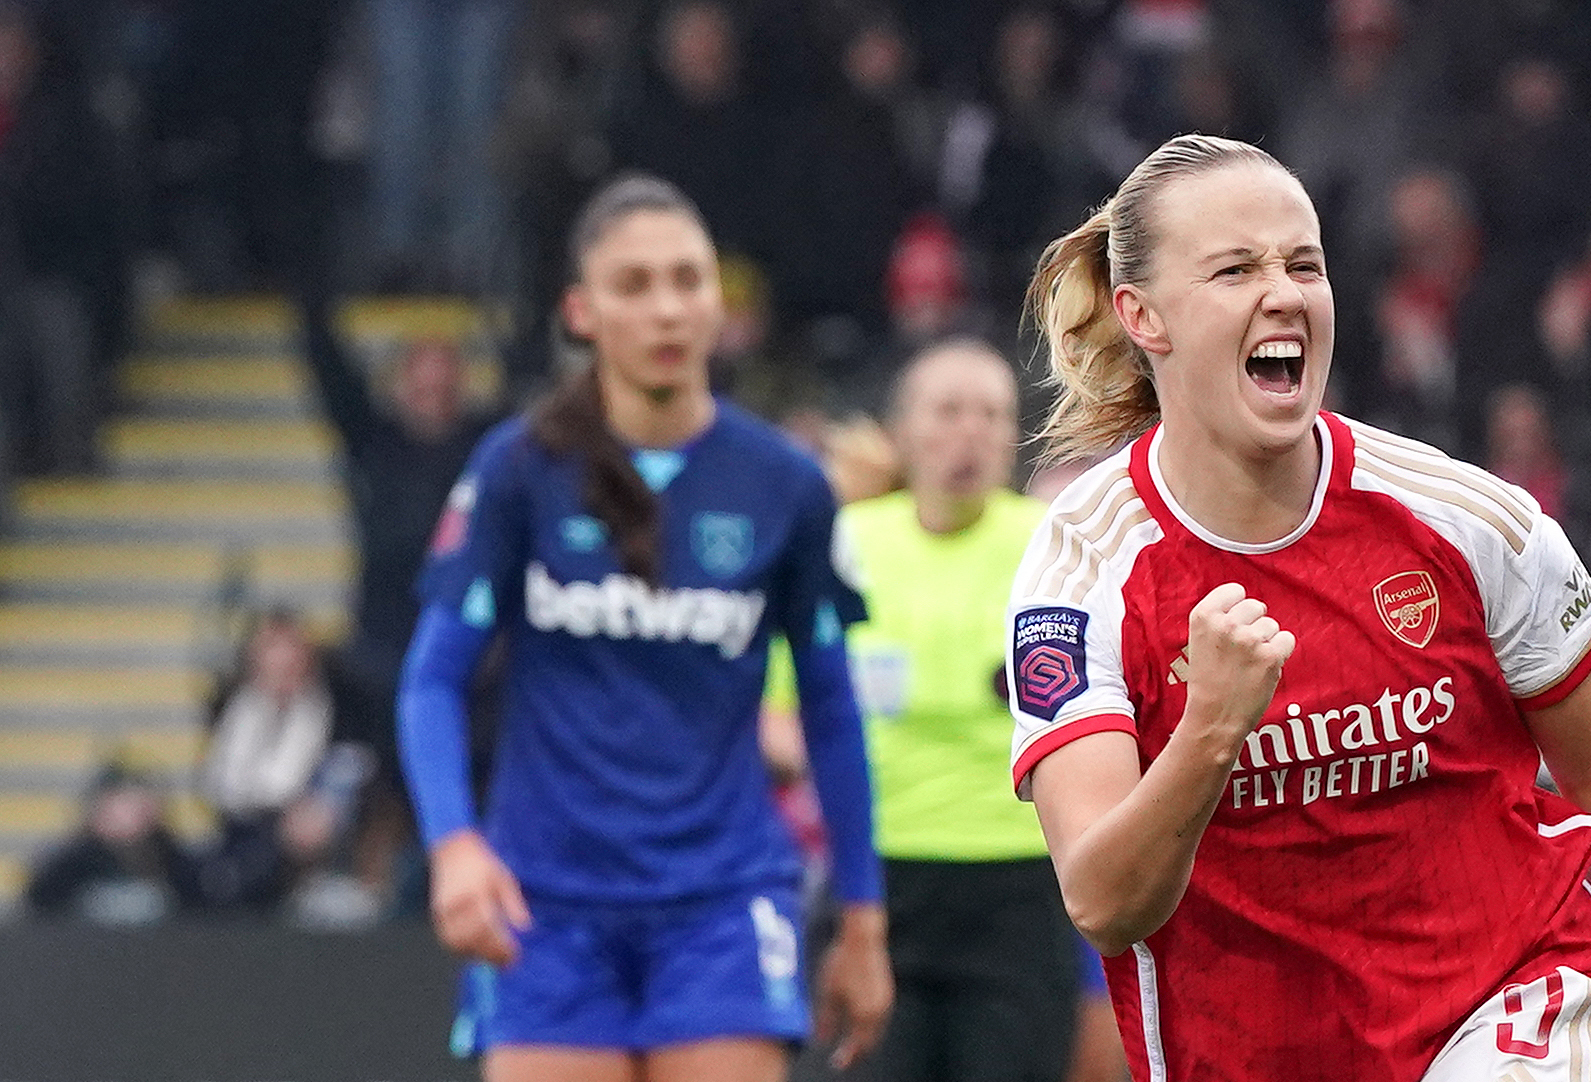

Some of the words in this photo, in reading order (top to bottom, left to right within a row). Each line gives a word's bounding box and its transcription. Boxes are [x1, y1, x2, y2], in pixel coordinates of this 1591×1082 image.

[525, 559, 767, 659] betway
[1383, 582, 1427, 605] Arsenal
[1017, 621, 1079, 641] WOMEN'S
[1027, 612, 1081, 627] BARCLAYS
[1230, 676, 1456, 773] mirates
[1233, 768, 1289, 809] FLY
[1303, 741, 1430, 806] BETTER
